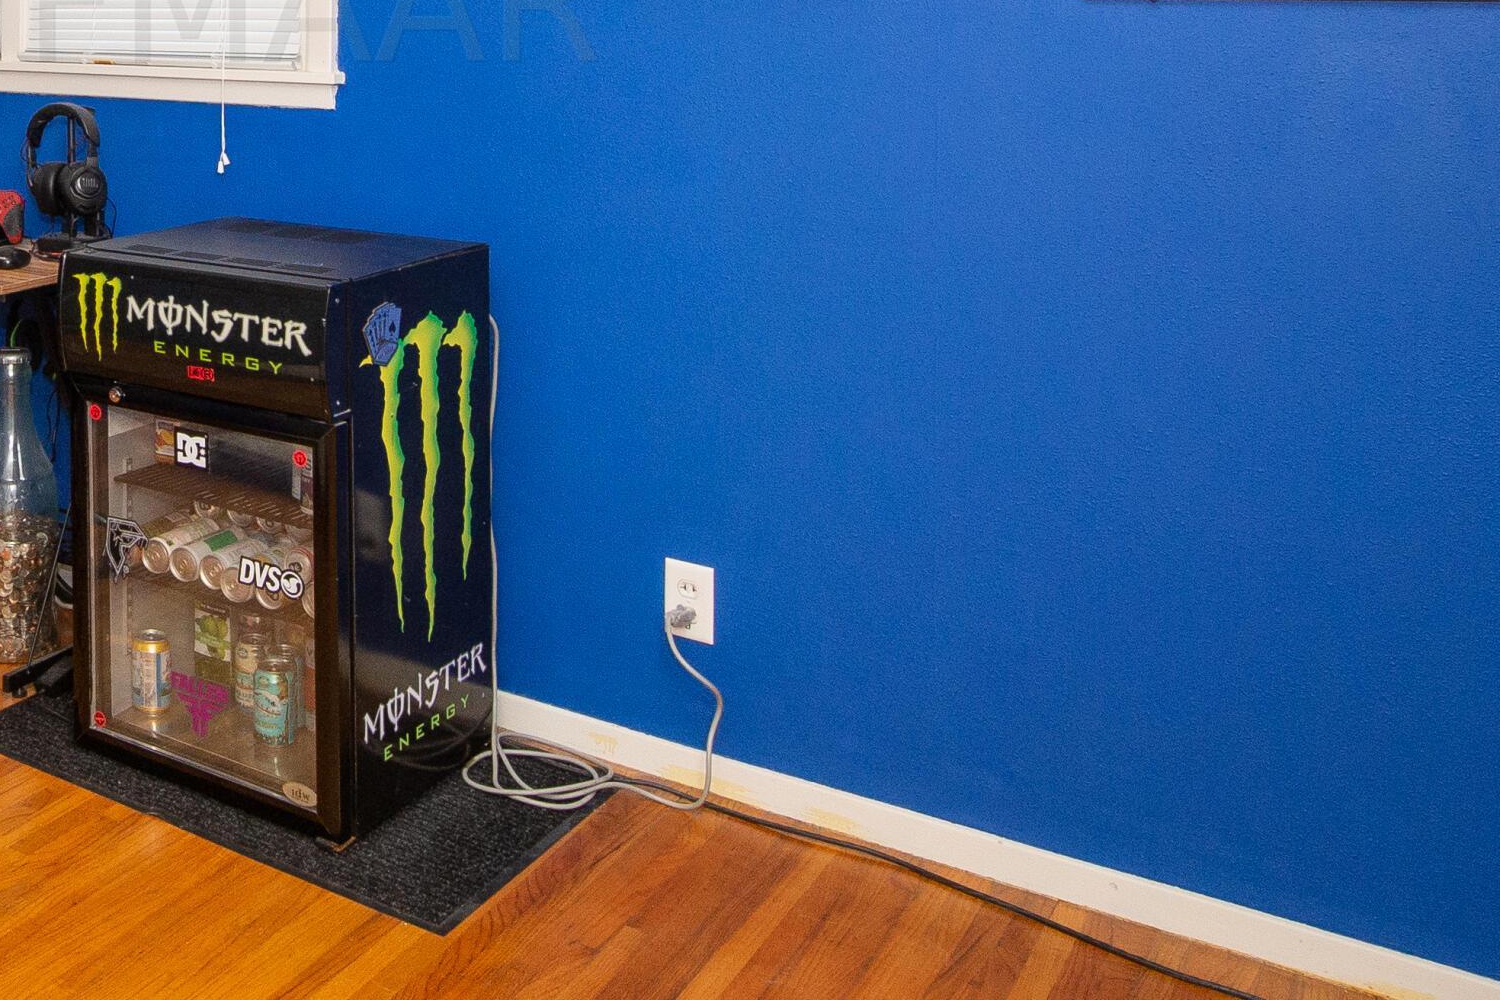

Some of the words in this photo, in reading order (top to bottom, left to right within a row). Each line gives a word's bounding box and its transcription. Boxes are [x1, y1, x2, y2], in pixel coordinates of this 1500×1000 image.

[125, 293, 312, 357] MONSTER
[153, 340, 284, 374] ENERGY
[238, 555, 283, 594] DVS
[362, 641, 488, 745] MONSTER
[383, 693, 470, 762] ENERGY
